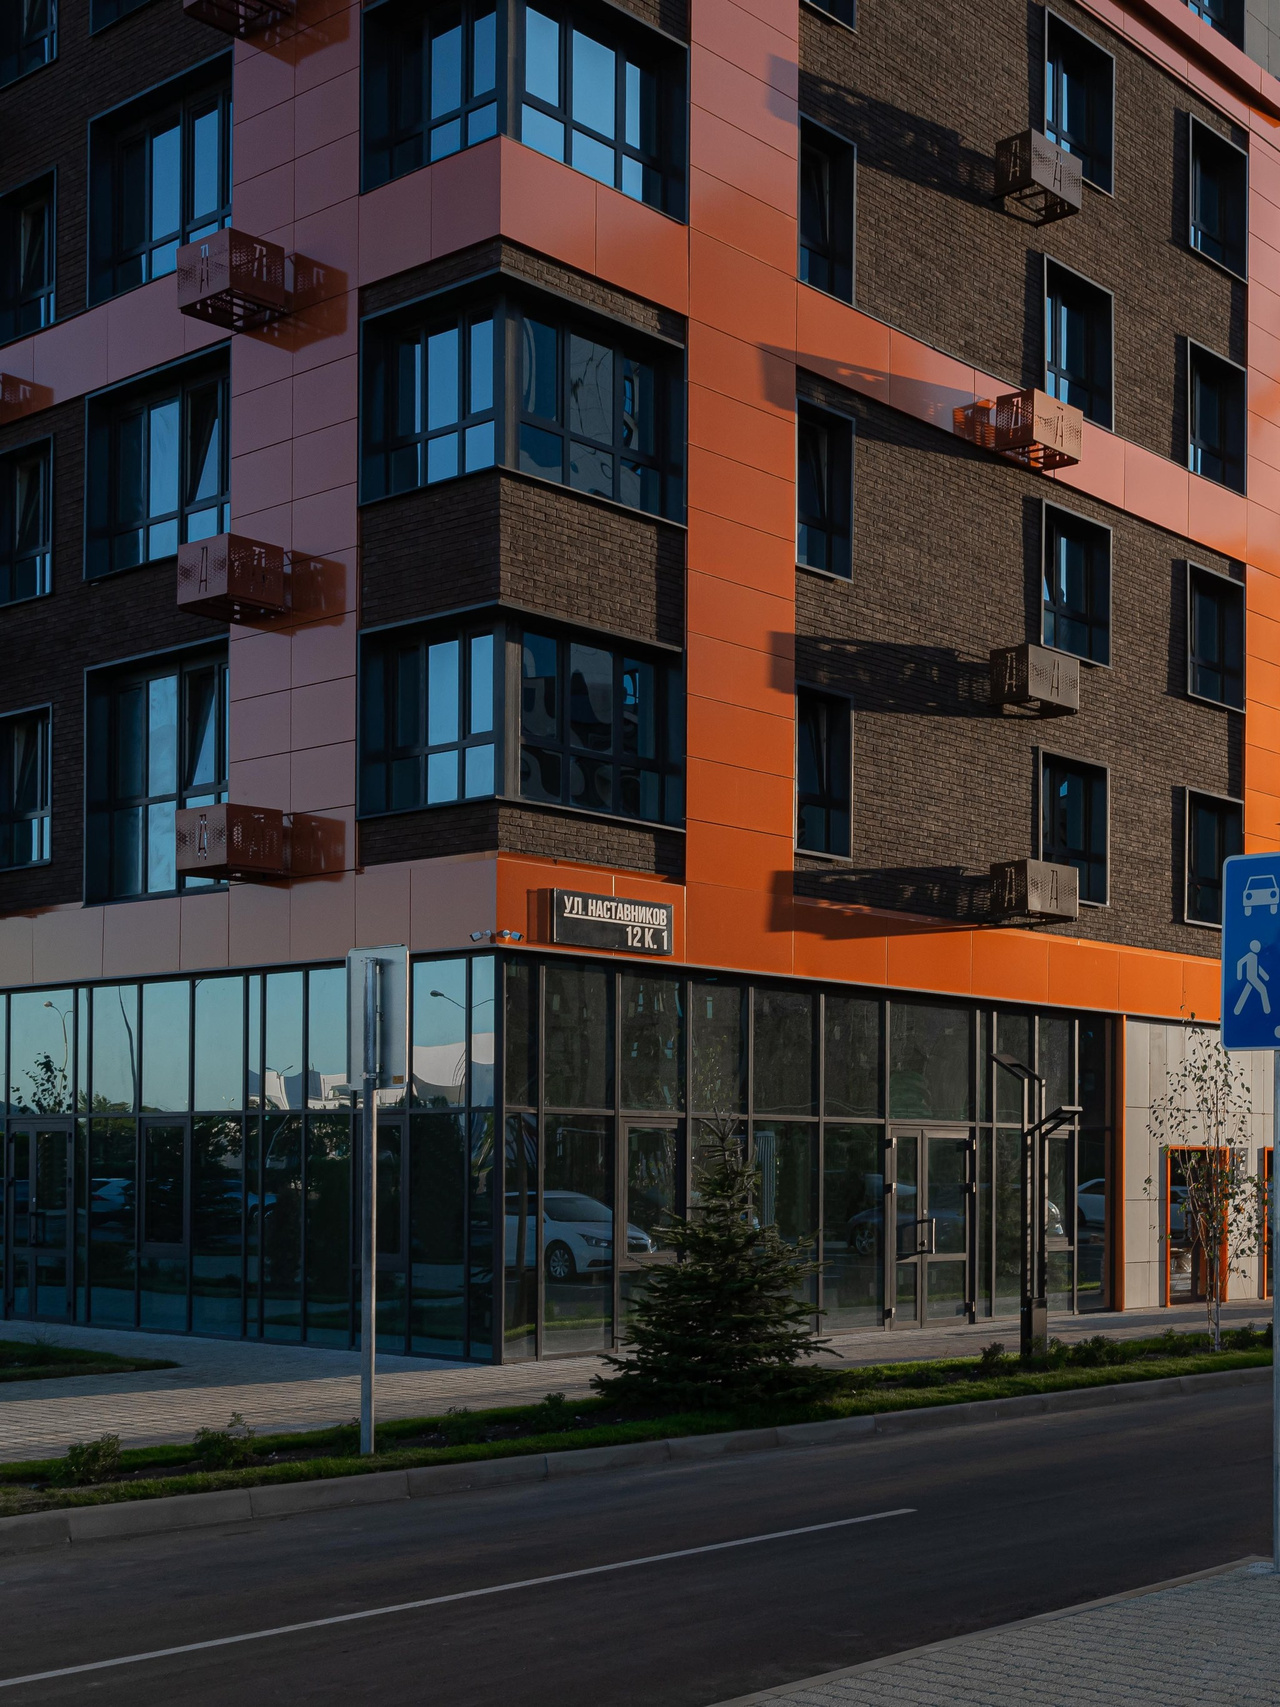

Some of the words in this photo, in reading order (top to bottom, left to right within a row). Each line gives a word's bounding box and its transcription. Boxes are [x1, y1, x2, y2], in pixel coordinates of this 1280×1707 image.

[564, 895, 585, 915] УЛ.
[588, 899, 667, 926] НАСТАВНИКОВ
[626, 926, 641, 947] 12
[645, 929, 657, 949] К.
[662, 931, 668, 950] 1
